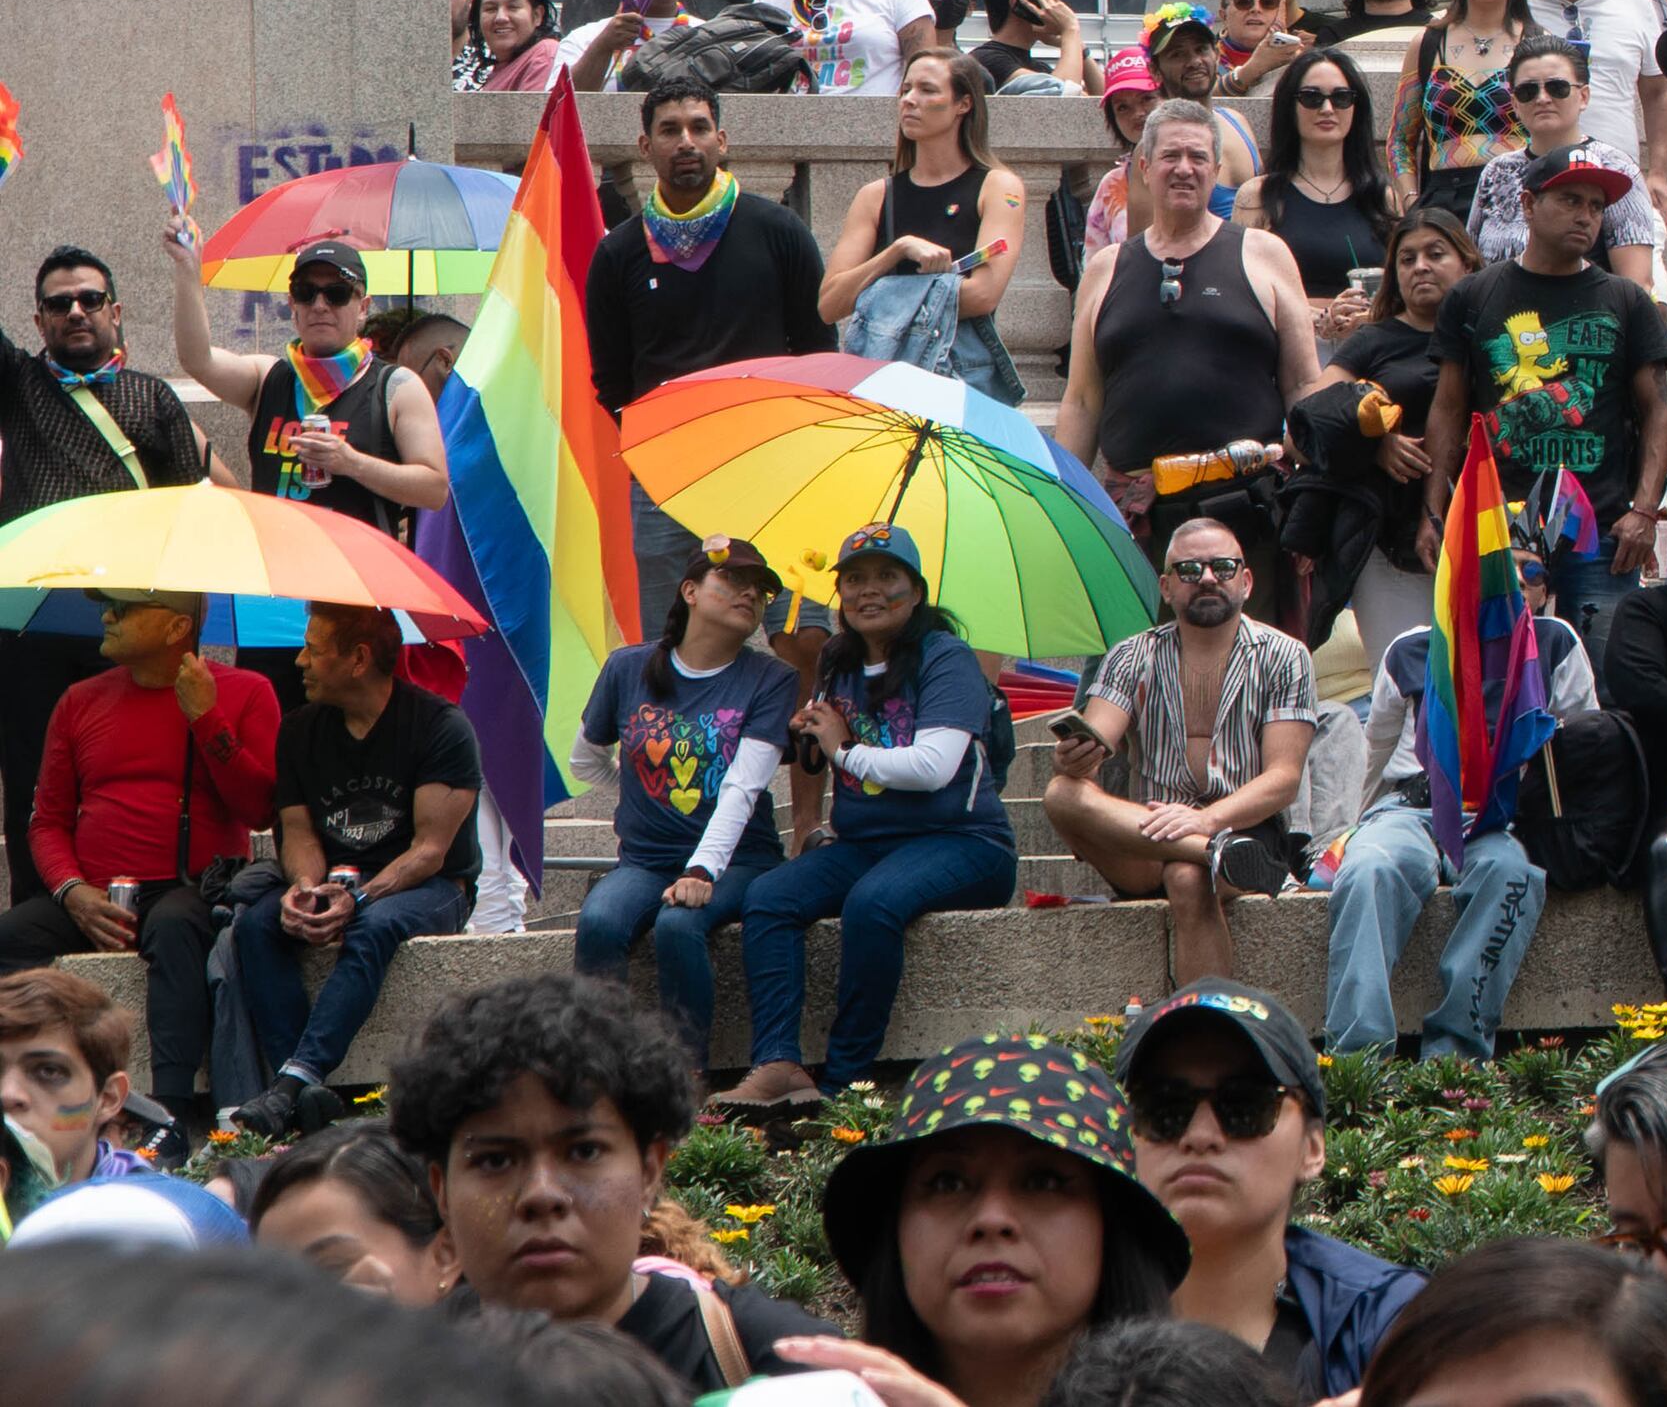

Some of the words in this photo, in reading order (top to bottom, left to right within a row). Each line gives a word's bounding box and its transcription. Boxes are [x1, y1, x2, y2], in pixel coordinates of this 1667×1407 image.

[1566, 319, 1606, 346] EAT
[1575, 357, 1609, 388] MY
[263, 415, 350, 458] LOE
[1520, 437, 1597, 467] SHORTS
[277, 462, 312, 501] IS
[320, 776, 403, 806] LACOSTE
